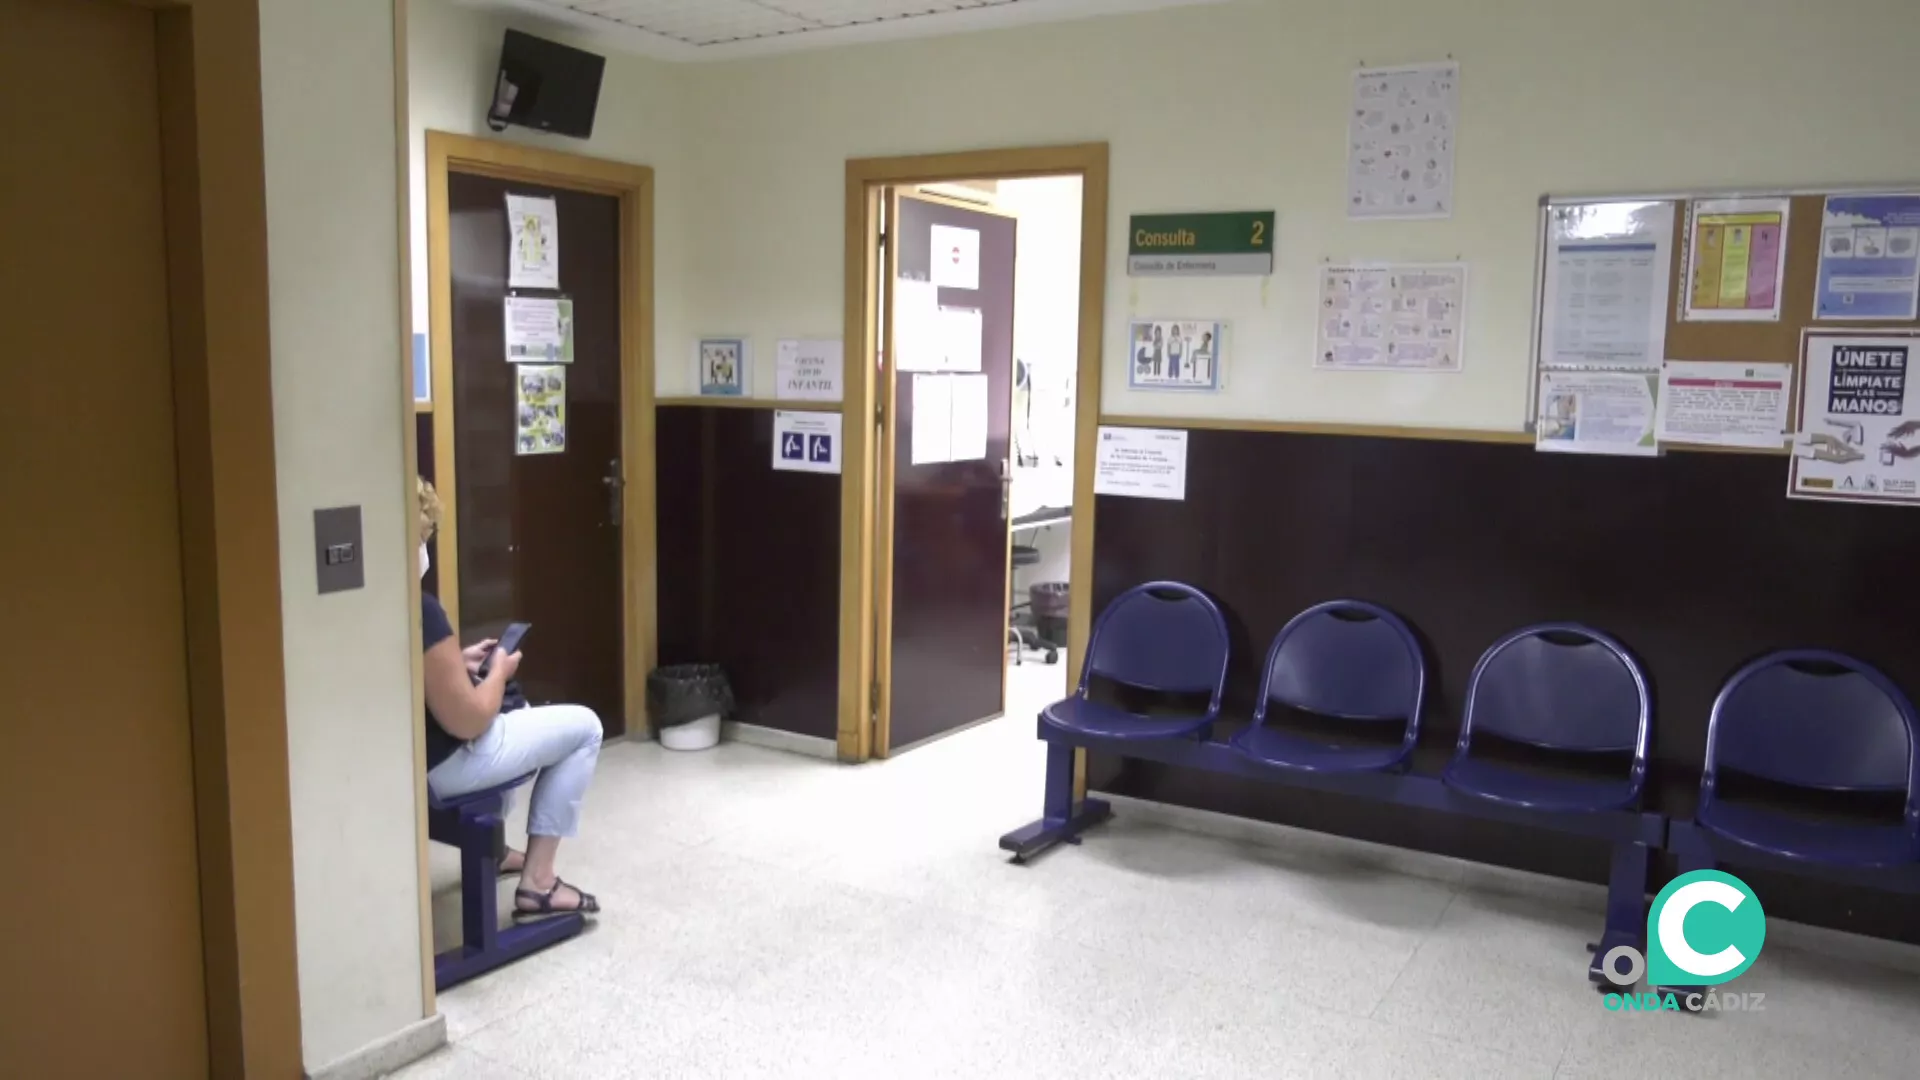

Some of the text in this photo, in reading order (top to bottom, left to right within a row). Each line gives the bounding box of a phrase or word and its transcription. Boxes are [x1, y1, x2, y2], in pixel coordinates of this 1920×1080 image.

[1136, 220, 1265, 247] Consulta 2
[1835, 346, 1904, 368] ÚNETE
[1856, 389, 1875, 397] LAS
[1831, 398, 1899, 413] MANOS
